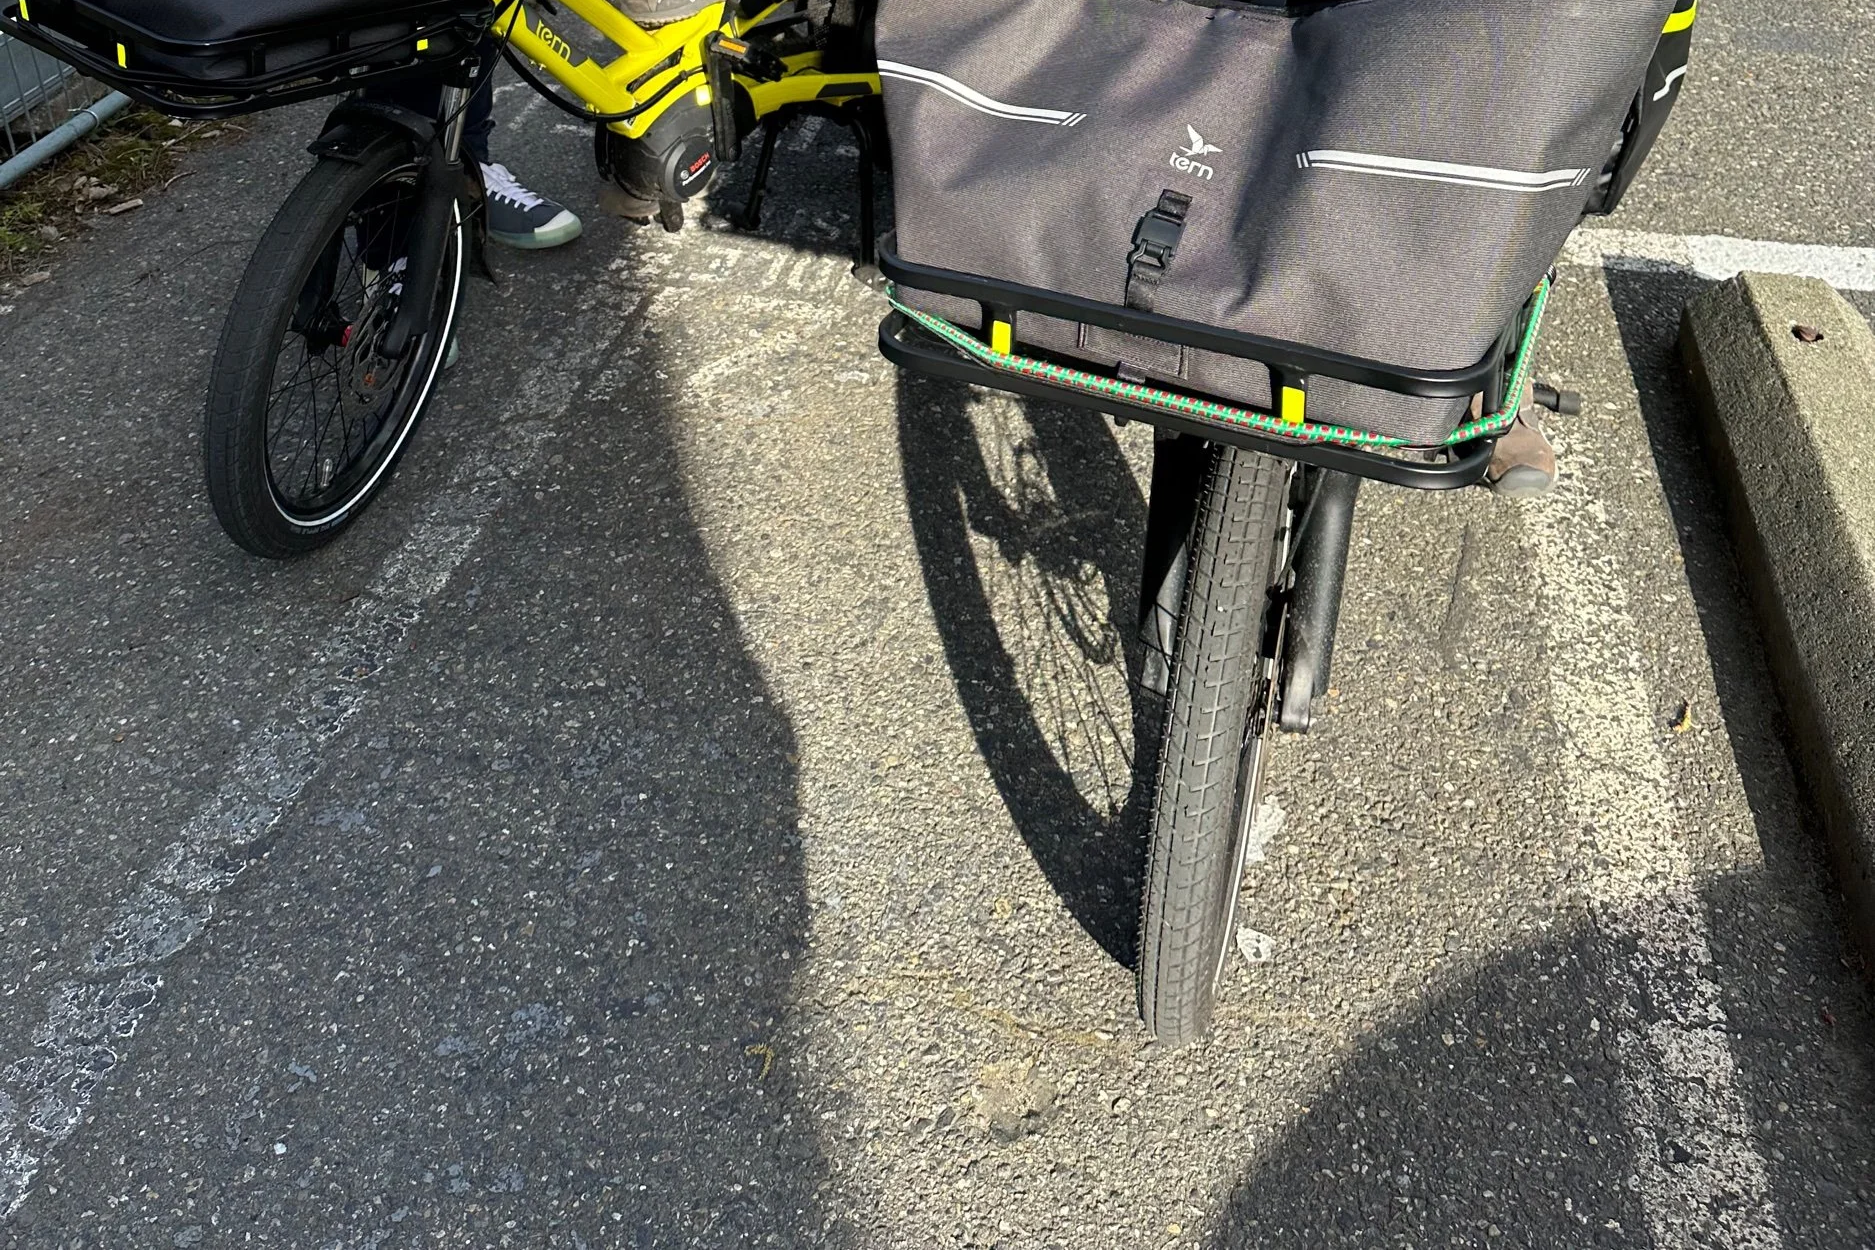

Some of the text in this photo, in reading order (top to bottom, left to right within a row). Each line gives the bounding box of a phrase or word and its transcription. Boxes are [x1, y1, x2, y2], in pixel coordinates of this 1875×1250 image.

[536, 19, 571, 62] tern
[690, 152, 710, 172] BOSCH
[1169, 152, 1213, 180] tern
